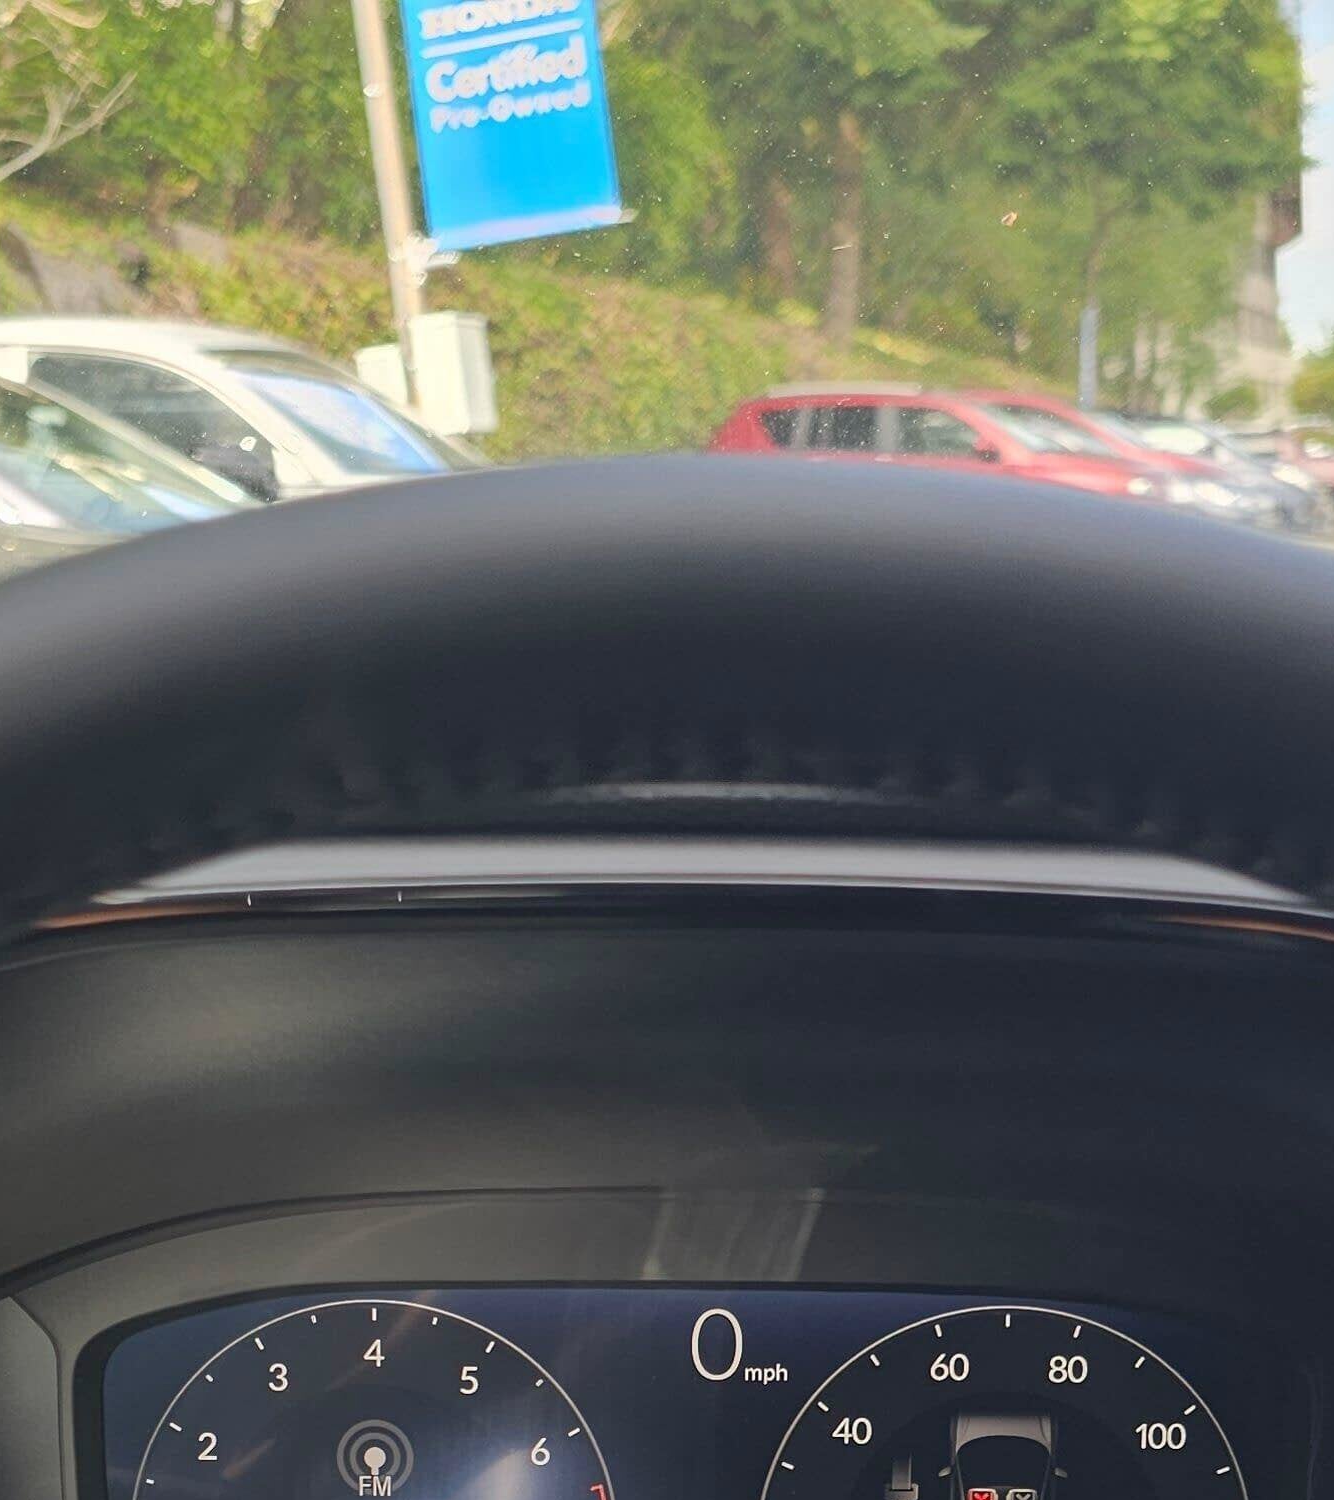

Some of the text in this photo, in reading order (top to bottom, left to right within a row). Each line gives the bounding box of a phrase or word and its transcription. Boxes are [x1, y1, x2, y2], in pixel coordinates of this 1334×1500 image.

[425, 34, 588, 104] Certified
[364, 1340, 385, 1367] 4
[691, 1308, 788, 1385] 0 mph
[268, 1364, 289, 1391] 3
[460, 1367, 479, 1394] 5
[930, 1354, 970, 1380] 60
[1048, 1356, 1088, 1383] 80
[832, 1418, 873, 1444] 40
[1136, 1424, 1187, 1450] 100
[197, 1434, 218, 1461] 2
[530, 1438, 550, 1465] 6
[359, 1477, 391, 1496] FM
